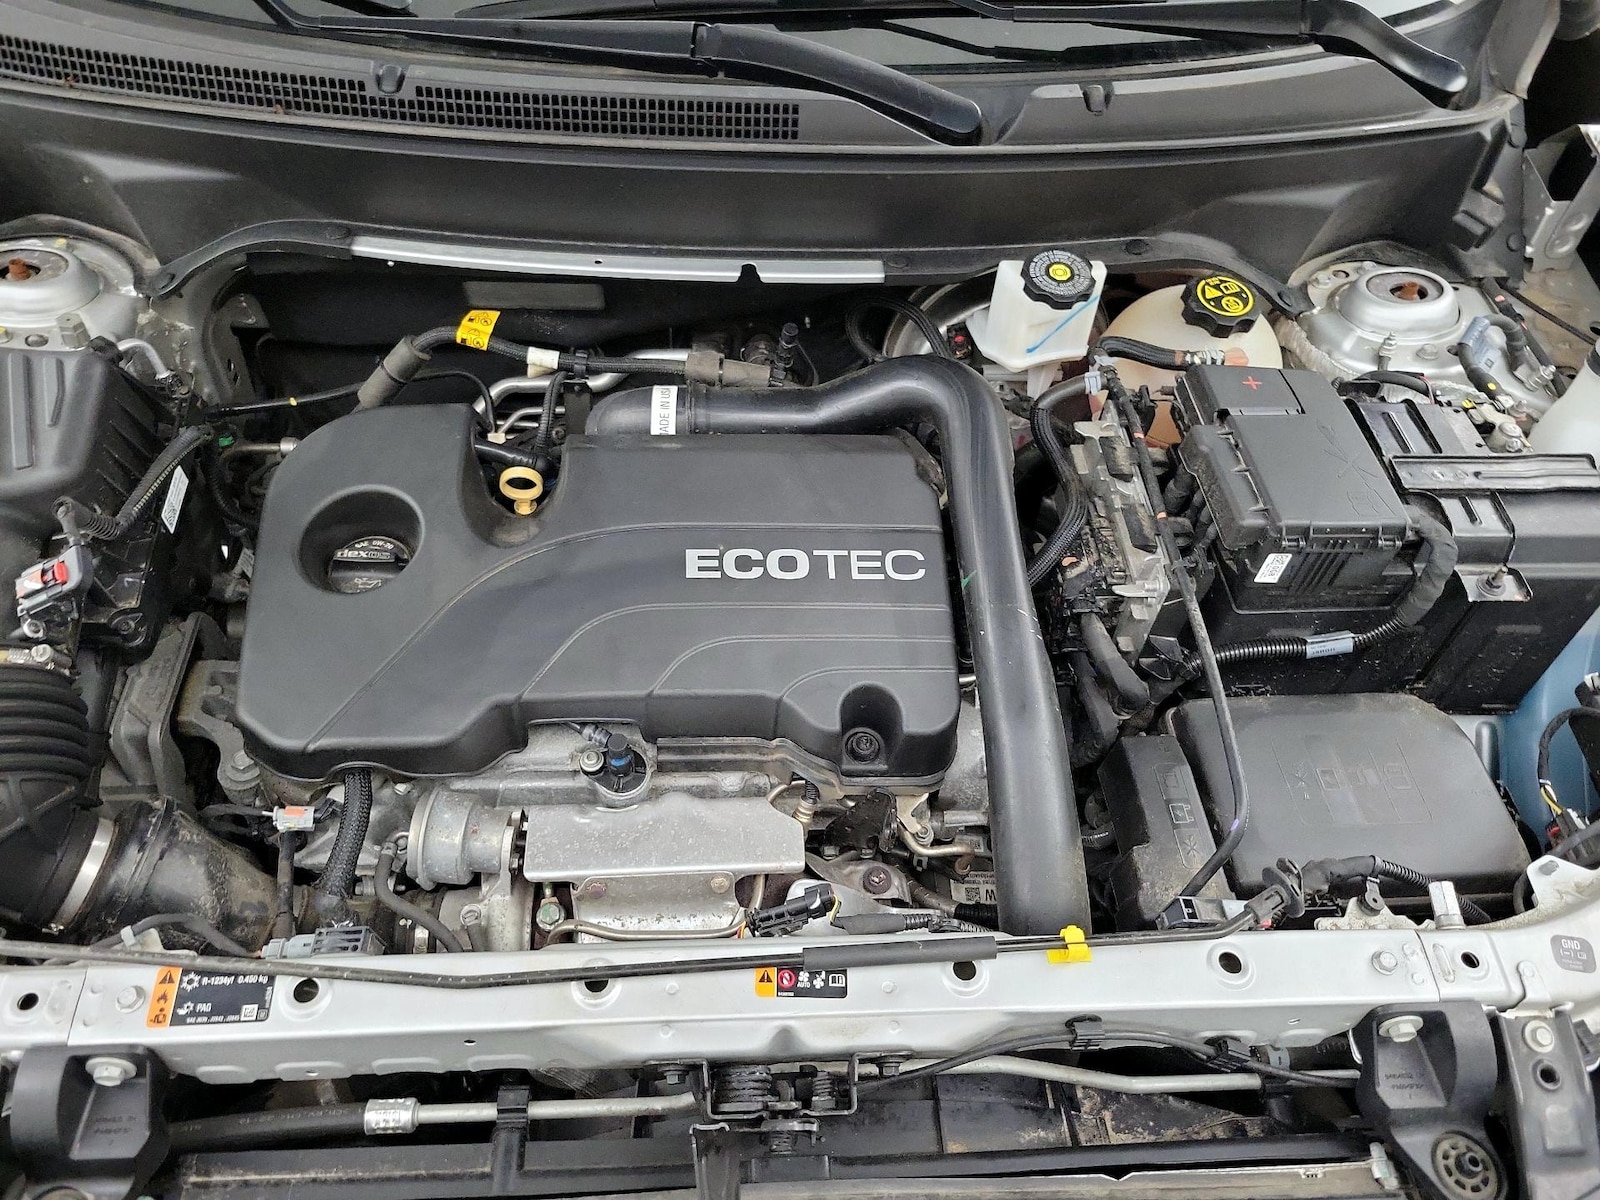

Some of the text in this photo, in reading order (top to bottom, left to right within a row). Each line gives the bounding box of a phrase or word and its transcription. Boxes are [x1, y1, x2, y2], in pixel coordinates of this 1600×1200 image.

[660, 401, 670, 410] IN
[337, 549, 391, 560] dexos
[685, 548, 926, 580] ECOTEC
[1561, 938, 1581, 950] GND
[258, 975, 269, 985] kg
